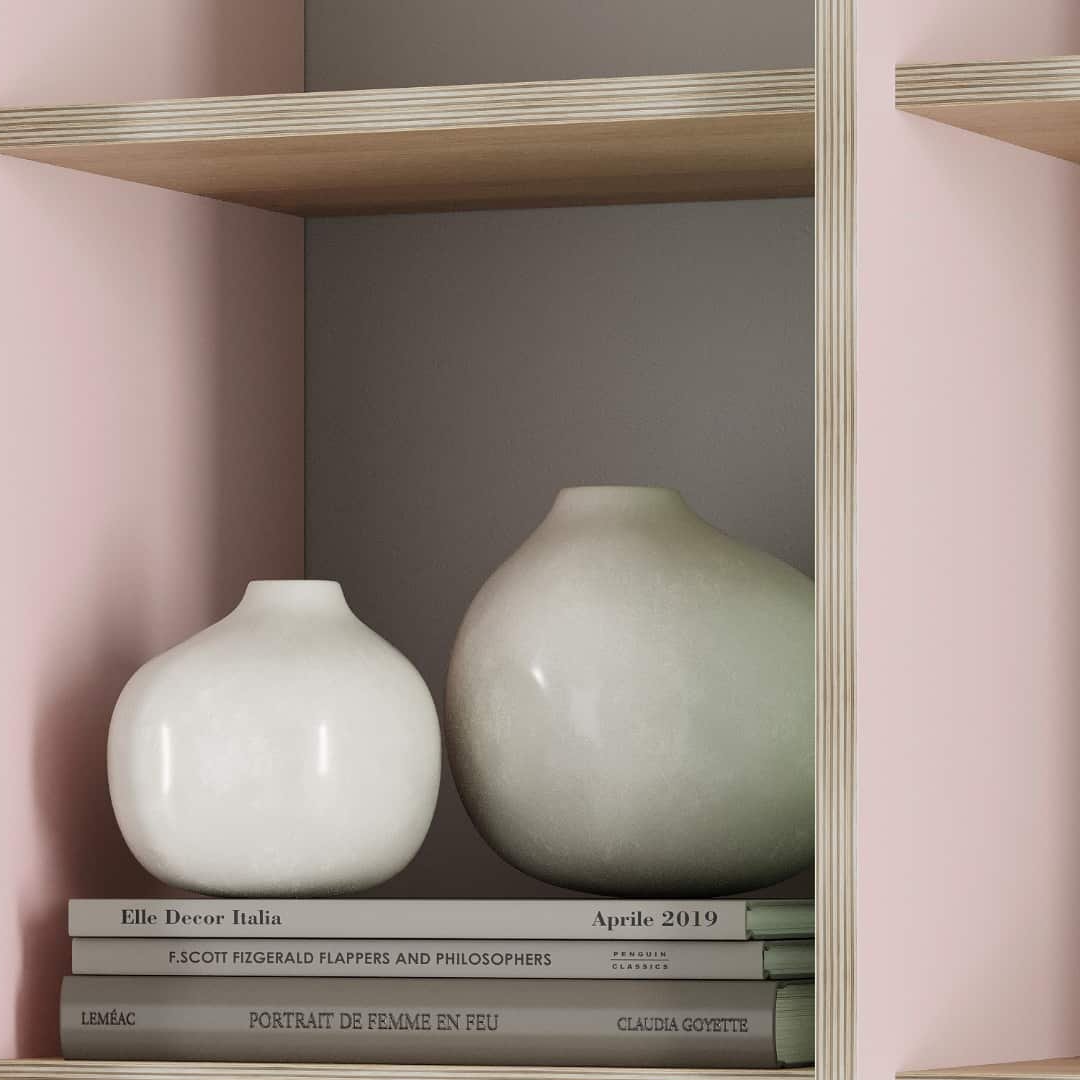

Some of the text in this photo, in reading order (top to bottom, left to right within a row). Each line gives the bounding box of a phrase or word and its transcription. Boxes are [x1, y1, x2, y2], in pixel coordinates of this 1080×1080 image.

[121, 909, 283, 926] Elle Decor Italia
[592, 910, 718, 931] Aprile 2019
[169, 951, 552, 966] F.SCOTT FIZGERALD FLAPPERS AND PHILOSOPHERS
[81, 1009, 136, 1026] LEMÉAC
[249, 1011, 499, 1031] PORTRAIT DE FEMME EN FEU
[617, 1016, 748, 1033] CLAUDIA GOYETTE
